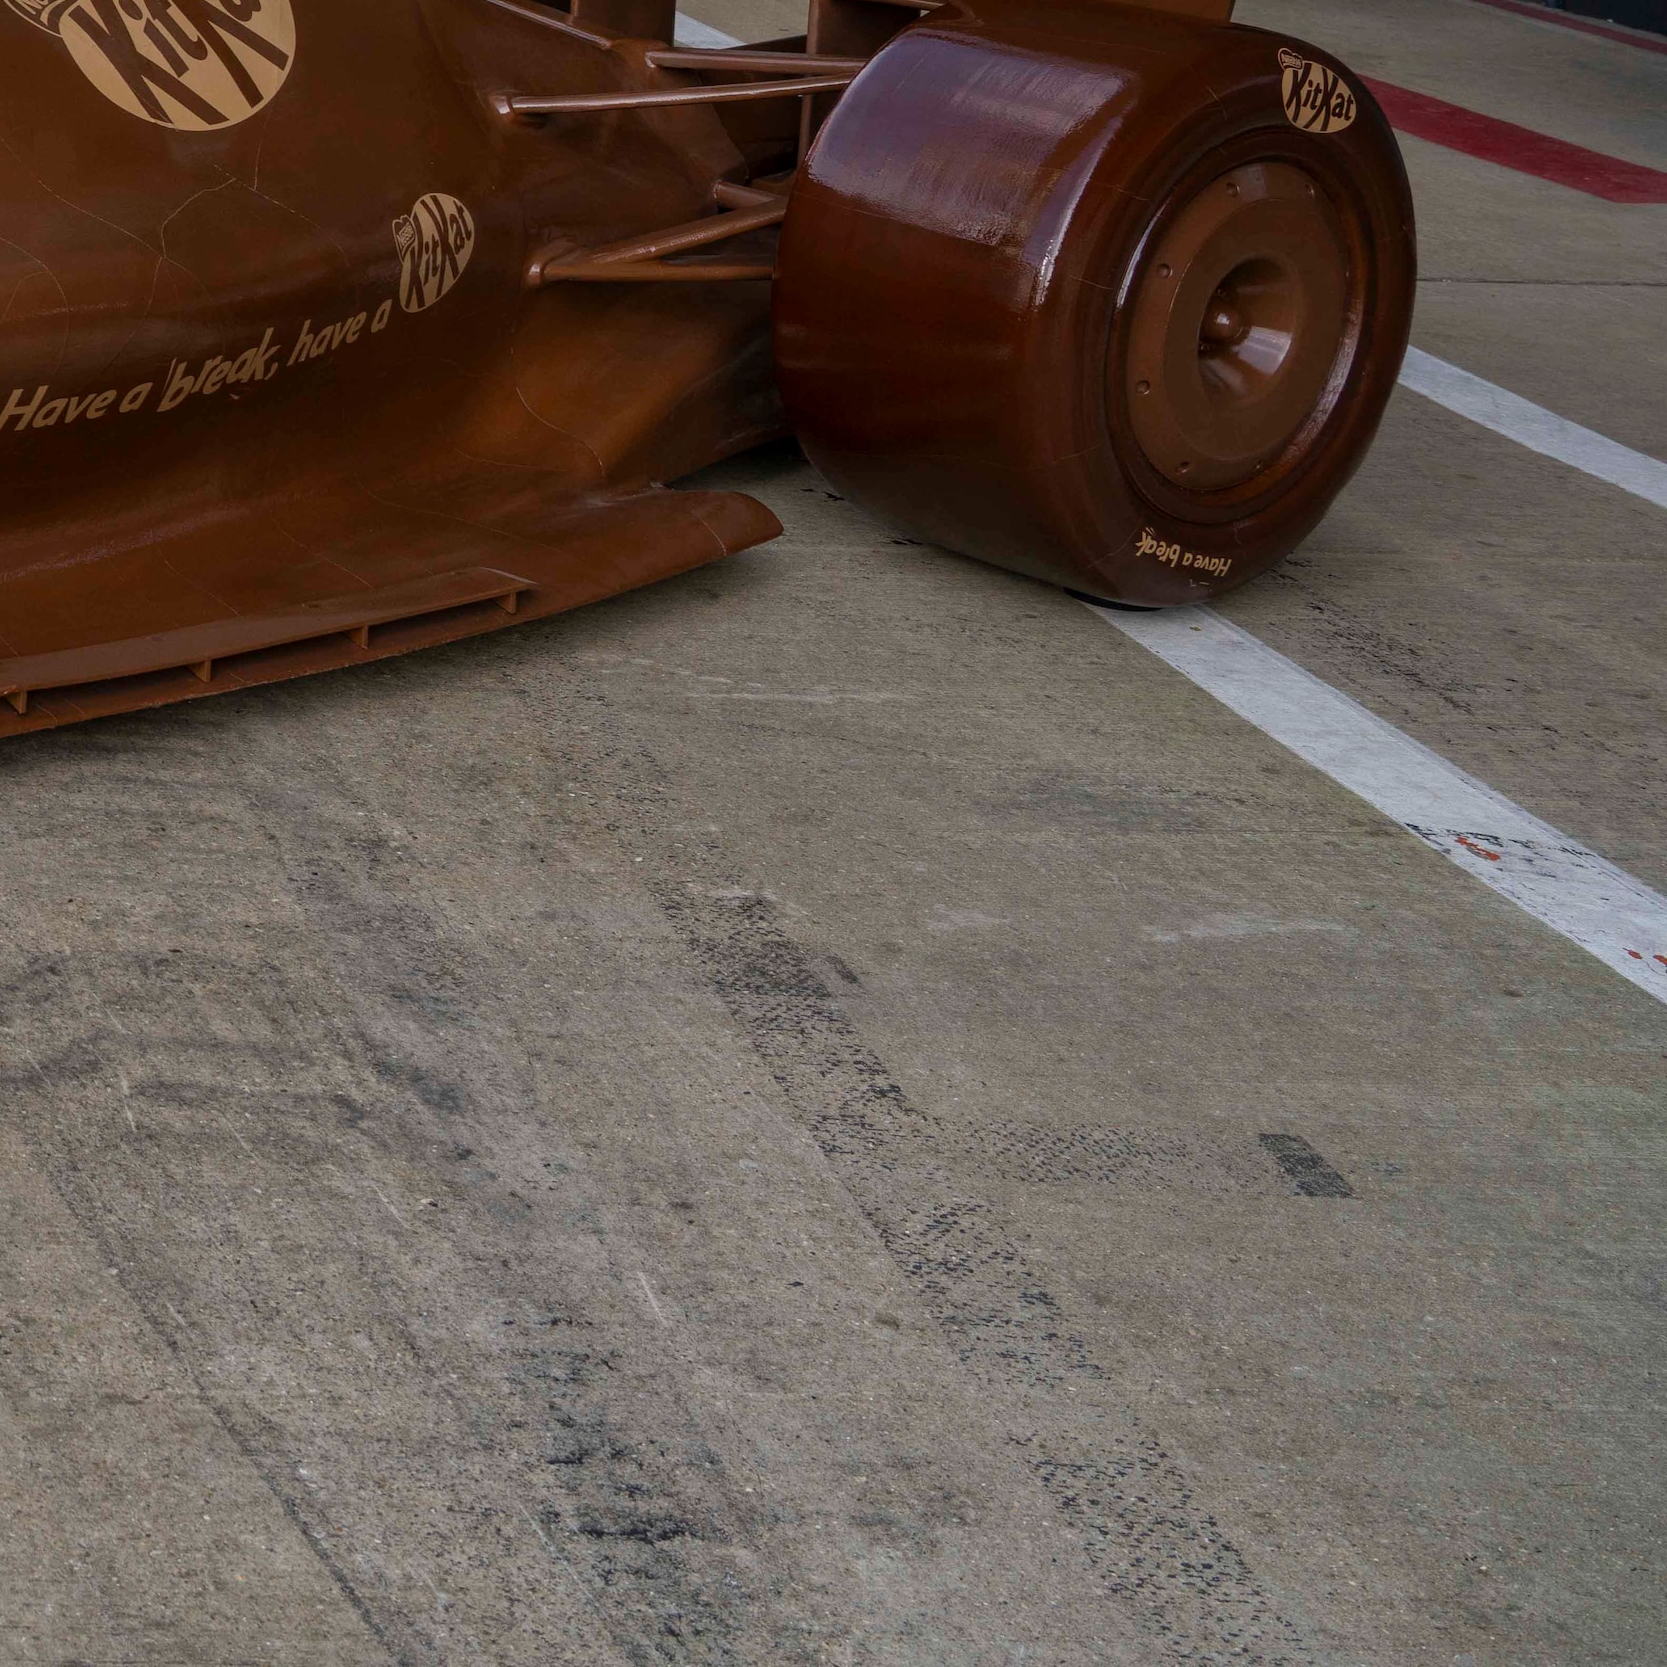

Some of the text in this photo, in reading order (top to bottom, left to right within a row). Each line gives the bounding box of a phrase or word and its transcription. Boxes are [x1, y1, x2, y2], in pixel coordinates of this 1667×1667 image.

[1285, 62, 1354, 132] KitKat
[119, 382, 154, 413] a
[155, 326, 283, 413] break,
[286, 318, 367, 367] have
[370, 299, 394, 334] a
[404, 194, 472, 310] KitKat
[1134, 530, 1232, 577] Have a break
